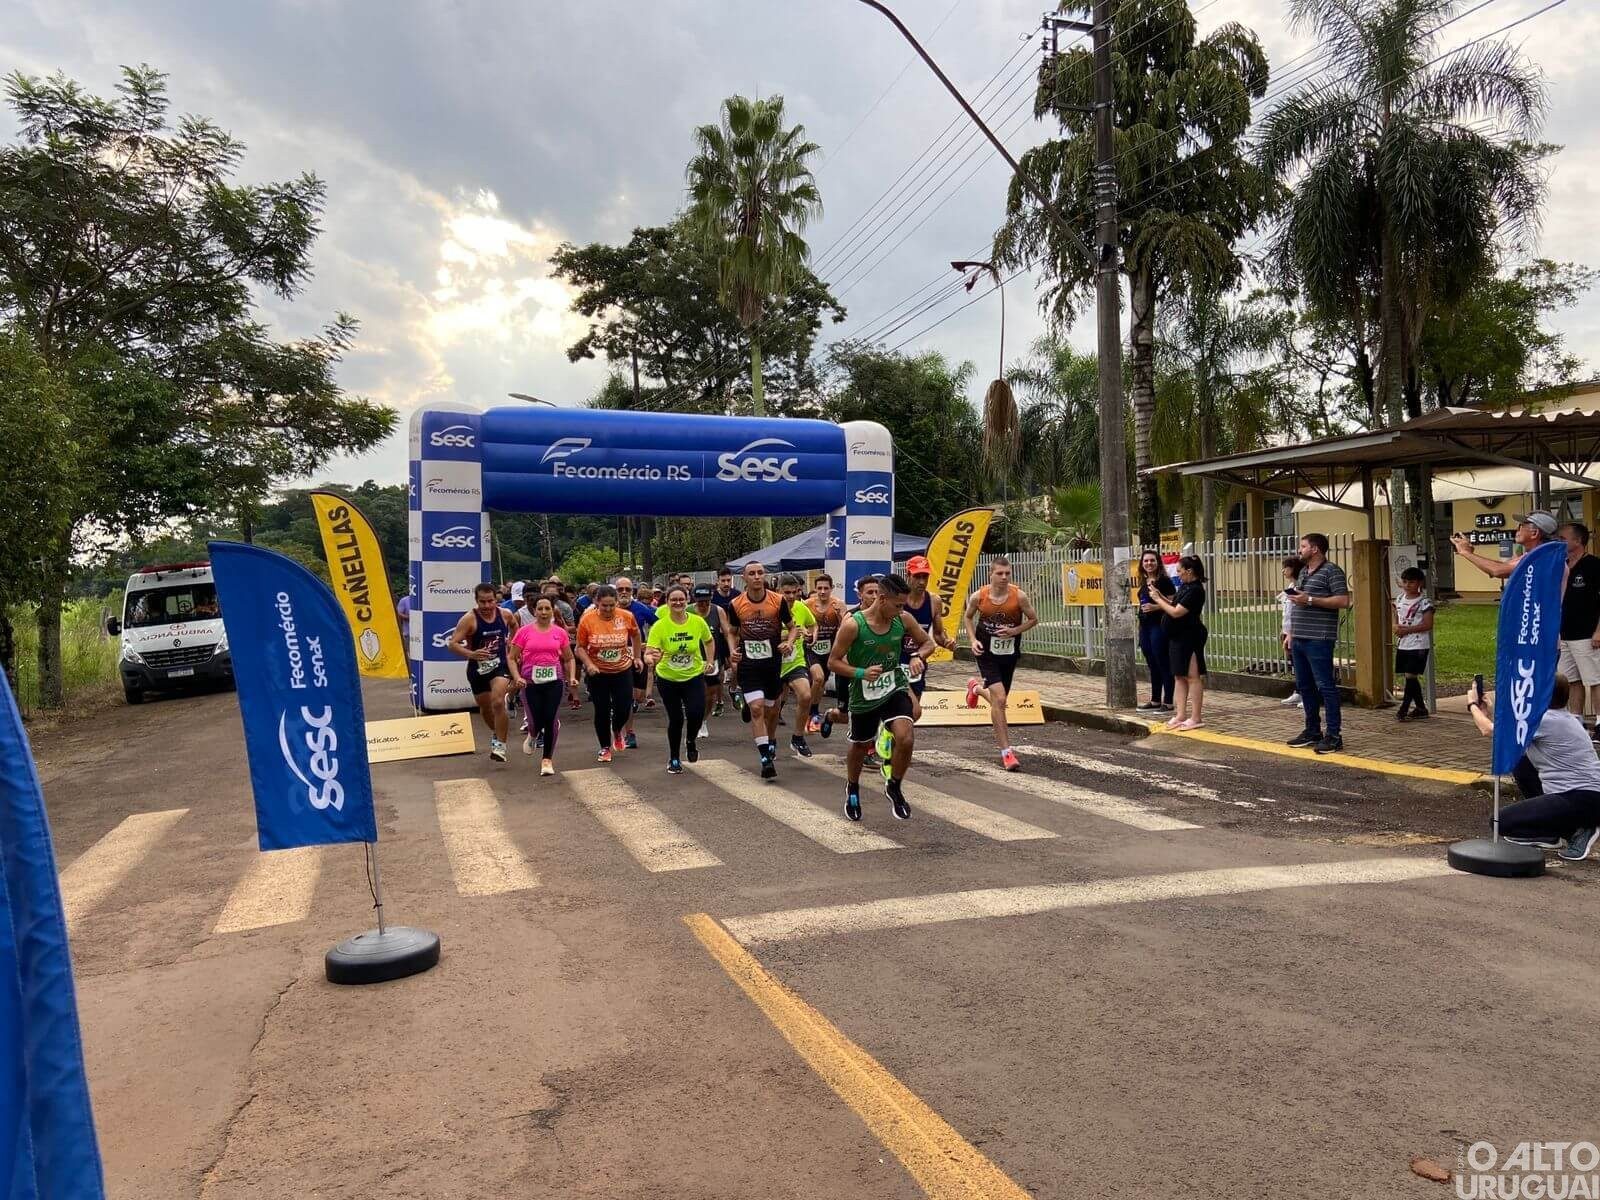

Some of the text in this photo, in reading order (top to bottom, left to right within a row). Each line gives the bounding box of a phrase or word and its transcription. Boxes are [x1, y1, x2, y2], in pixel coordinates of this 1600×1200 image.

[430, 431, 475, 448] Sesc
[553, 462, 692, 481] Fecomércio RS
[715, 452, 799, 482] Sesc
[429, 486, 470, 495] Fecomércio
[854, 490, 889, 504] Sesc
[431, 532, 476, 548] Sesc
[1478, 531, 1514, 543] CAÑELL
[328, 504, 373, 623] CAÑELLAS
[937, 520, 975, 618] CAÑELLAS
[429, 586, 471, 595] Fecomércio
[1086, 576, 1103, 590] RÚST
[1518, 564, 1535, 645] Fecomércio
[275, 591, 307, 689] Fecomércio
[993, 639, 1012, 650] 517
[748, 642, 767, 654] 561
[671, 655, 691, 664] 623
[535, 668, 554, 679] 586
[866, 674, 892, 691] 449
[430, 686, 472, 695] Fecomércio
[300, 705, 345, 812] Sesc
